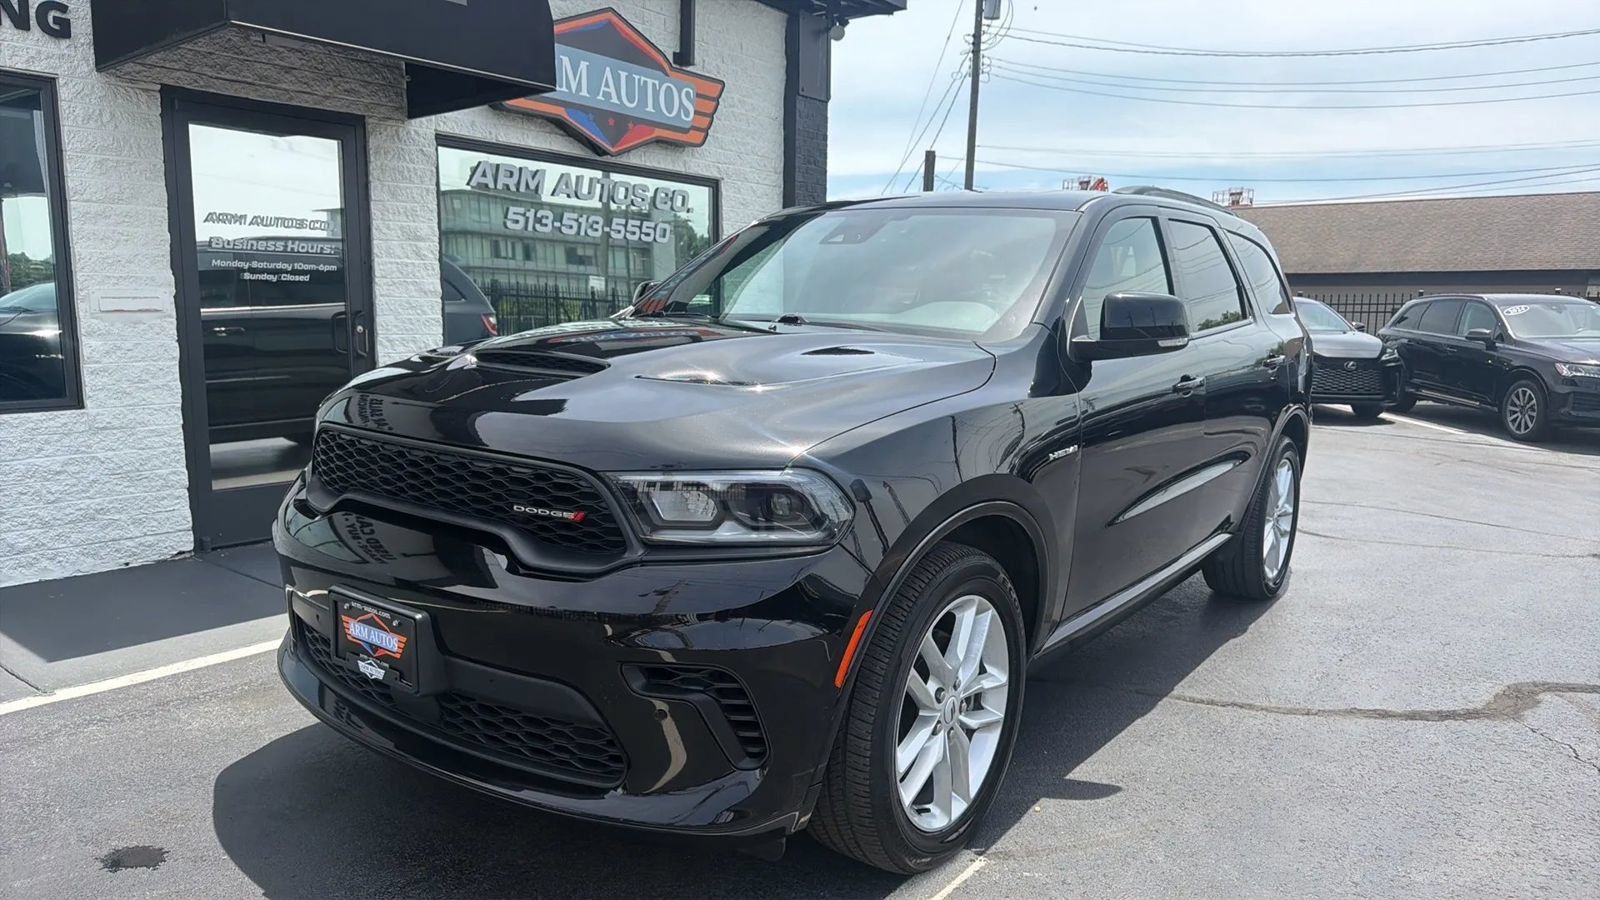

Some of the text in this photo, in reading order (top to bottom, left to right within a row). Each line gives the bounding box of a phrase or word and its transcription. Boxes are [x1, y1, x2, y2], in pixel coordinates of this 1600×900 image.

[597, 66, 695, 122] AUTOS
[467, 160, 547, 195] ARM
[551, 172, 650, 208] AUTOS
[504, 206, 671, 244] 513-513-5550
[210, 237, 336, 254] Business Hours:
[211, 259, 292, 272] Monday-Saturday
[243, 272, 310, 282] Sunday Closed
[513, 504, 575, 520] DODGE
[349, 622, 398, 651] ARM AUTOS
